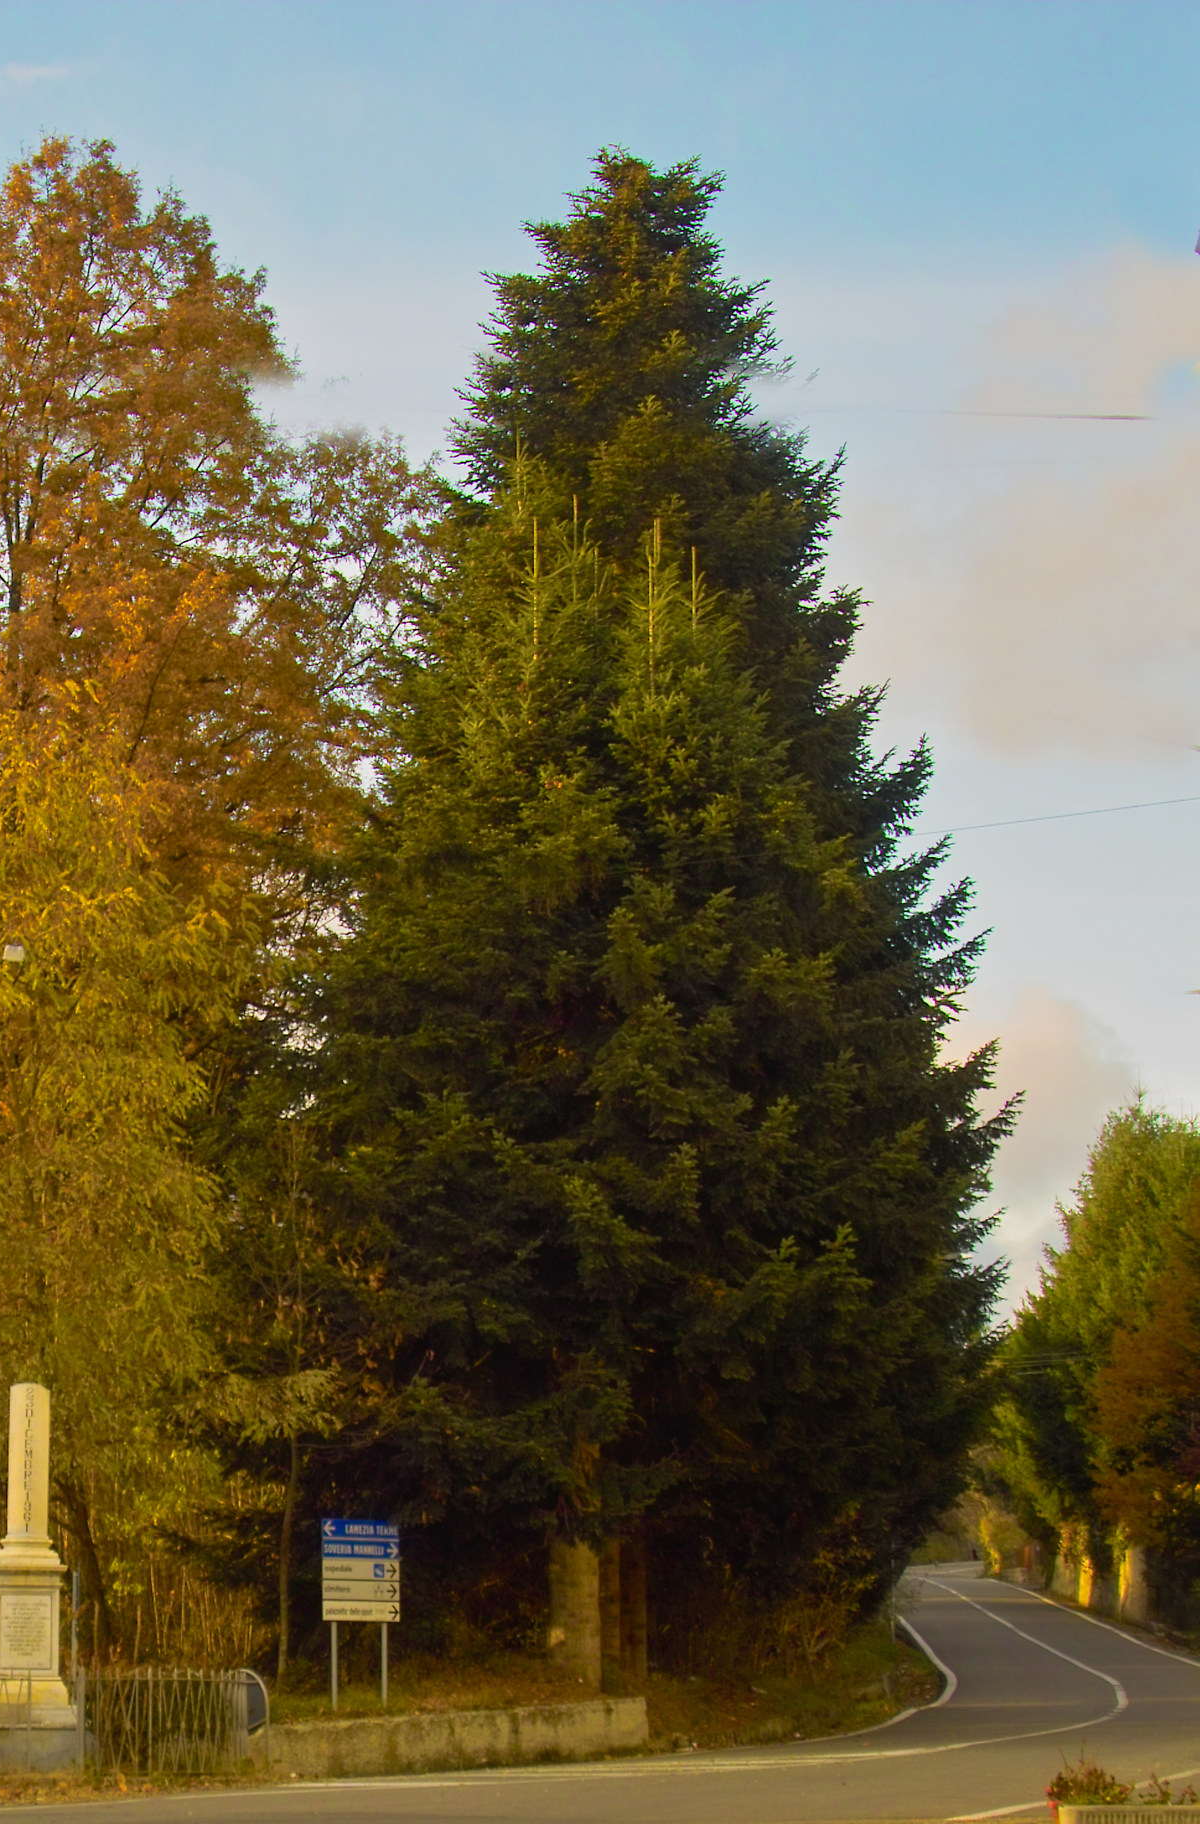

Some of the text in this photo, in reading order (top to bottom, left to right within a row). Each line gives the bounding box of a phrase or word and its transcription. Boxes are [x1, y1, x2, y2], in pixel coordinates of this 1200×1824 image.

[23, 1491, 32, 1533] 1961
[345, 1524, 398, 1536] LAMEZIA TERME
[324, 1543, 384, 1556] SOVERIA MANNELLI
[324, 1565, 352, 1573] ospedale
[324, 1585, 351, 1593] cimitero
